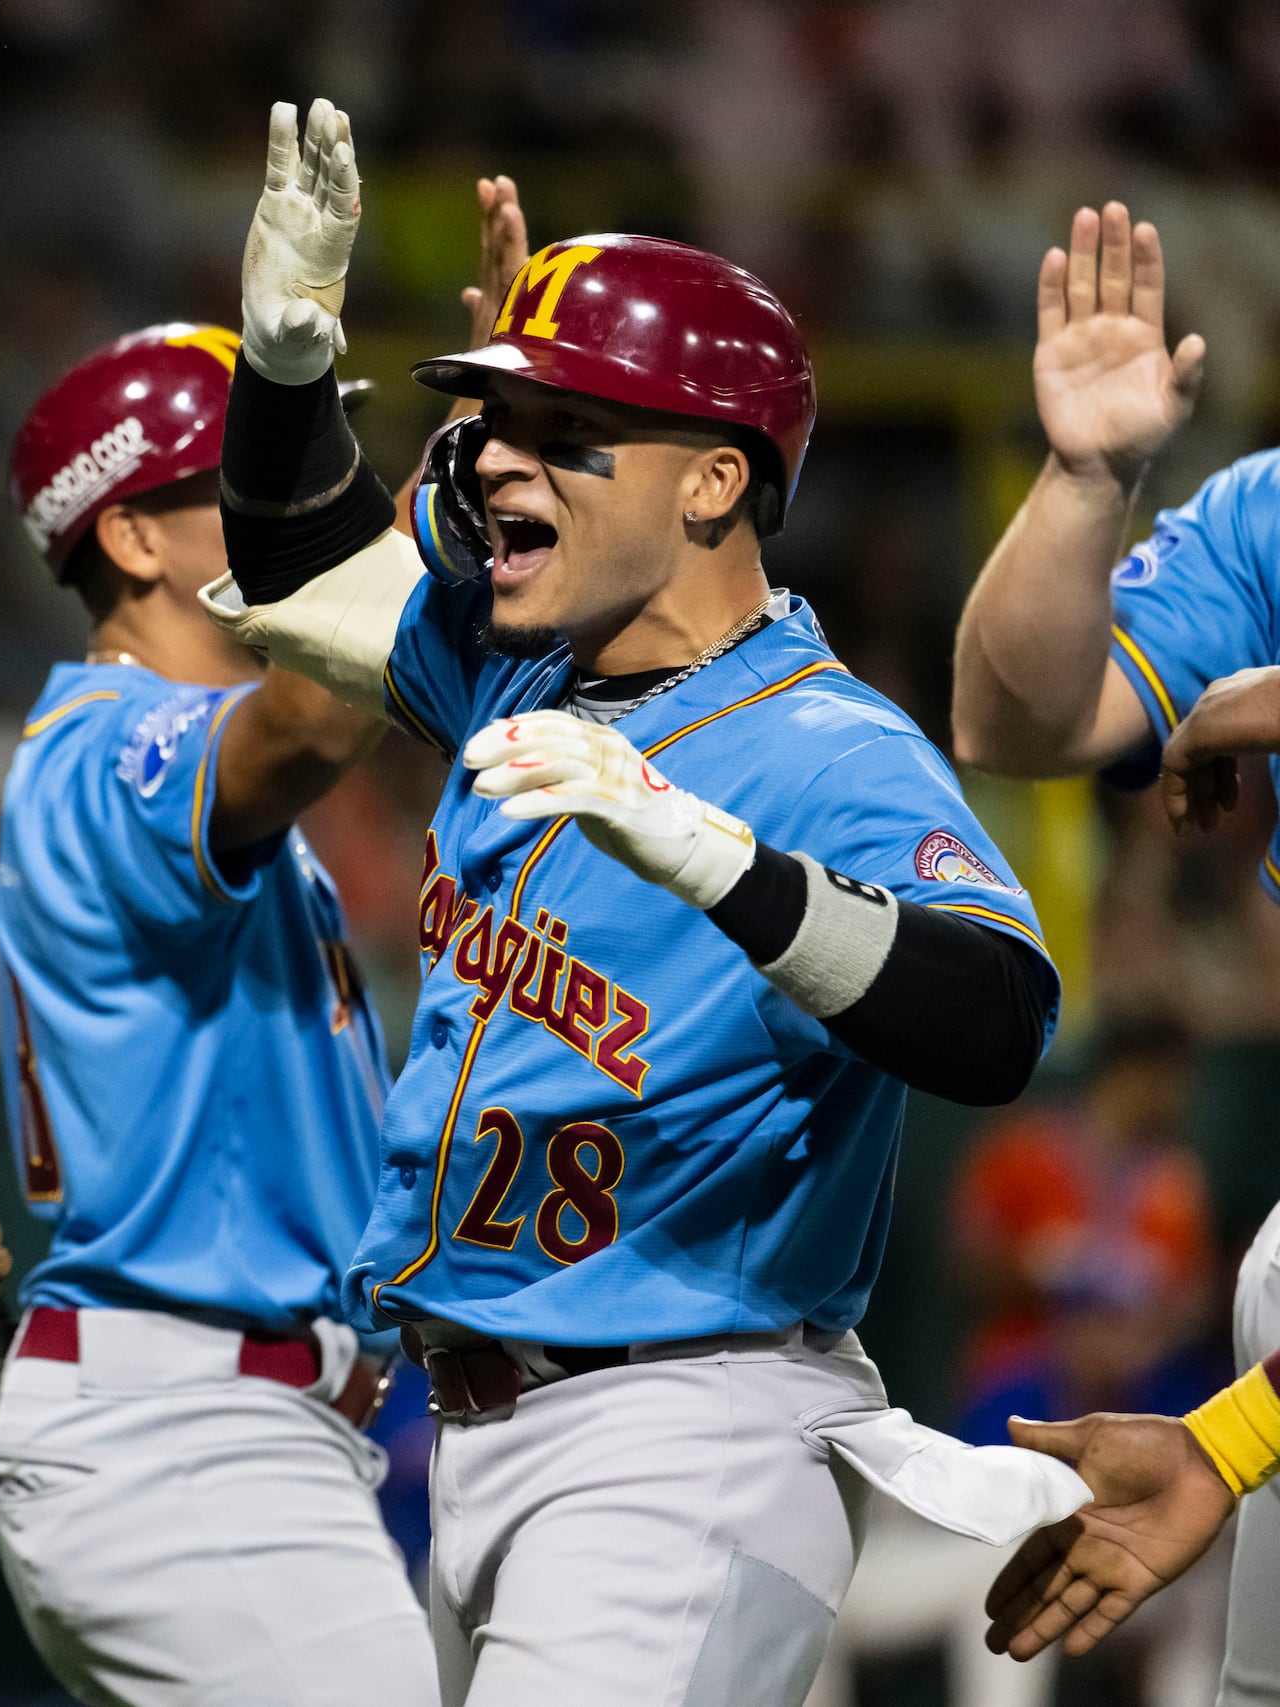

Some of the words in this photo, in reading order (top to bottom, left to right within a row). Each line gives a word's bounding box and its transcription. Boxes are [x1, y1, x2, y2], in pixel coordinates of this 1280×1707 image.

[493, 243, 604, 340] M
[419, 829, 652, 1100] ayagüez
[452, 1106, 625, 1266] 28
